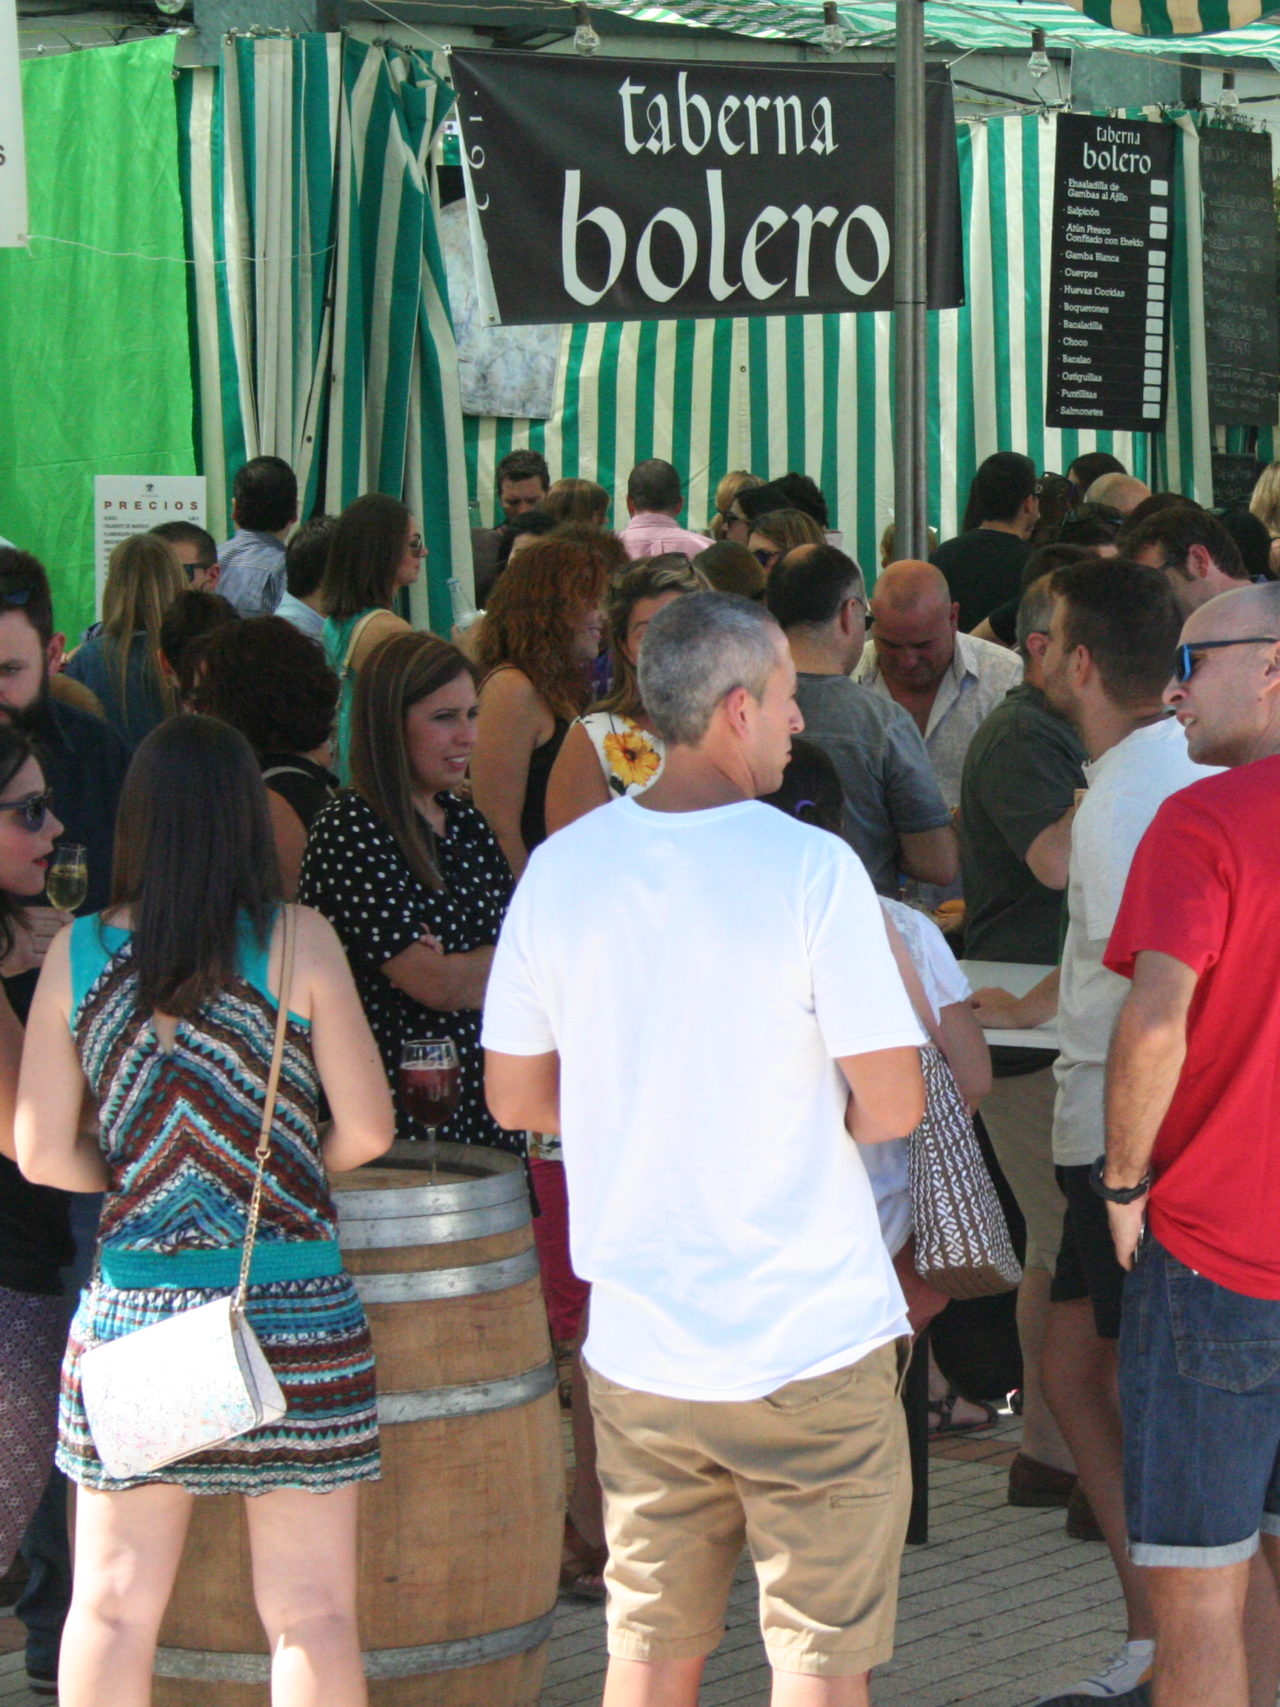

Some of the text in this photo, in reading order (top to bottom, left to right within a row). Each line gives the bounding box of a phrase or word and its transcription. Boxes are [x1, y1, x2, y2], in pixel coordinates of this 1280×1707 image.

[618, 71, 839, 155] taberna
[1096, 125, 1140, 145] taberna
[1083, 142, 1151, 174] bolero
[1068, 178, 1120, 191] Ensaladilla de
[1067, 188, 1128, 202] Gambas al Ajillo
[1067, 206, 1100, 217] Salpicón
[1066, 223, 1111, 235] Atún Fresco
[562, 169, 890, 306] bolero
[1065, 233, 1103, 244] Confitado
[1120, 237, 1144, 247] Eneldo
[1065, 250, 1120, 263] Gamba Blanca
[1064, 267, 1099, 279] Cuerpos
[1064, 285, 1125, 298] Huevas Cocidas
[1063, 302, 1109, 314] Boquerones
[1063, 320, 1103, 331] Bacaladilla
[1062, 337, 1088, 347] Choco
[1062, 354, 1092, 365] Bacalao
[1060, 406, 1104, 417] Salmonetes
[104, 501, 198, 510] PRECIOS
